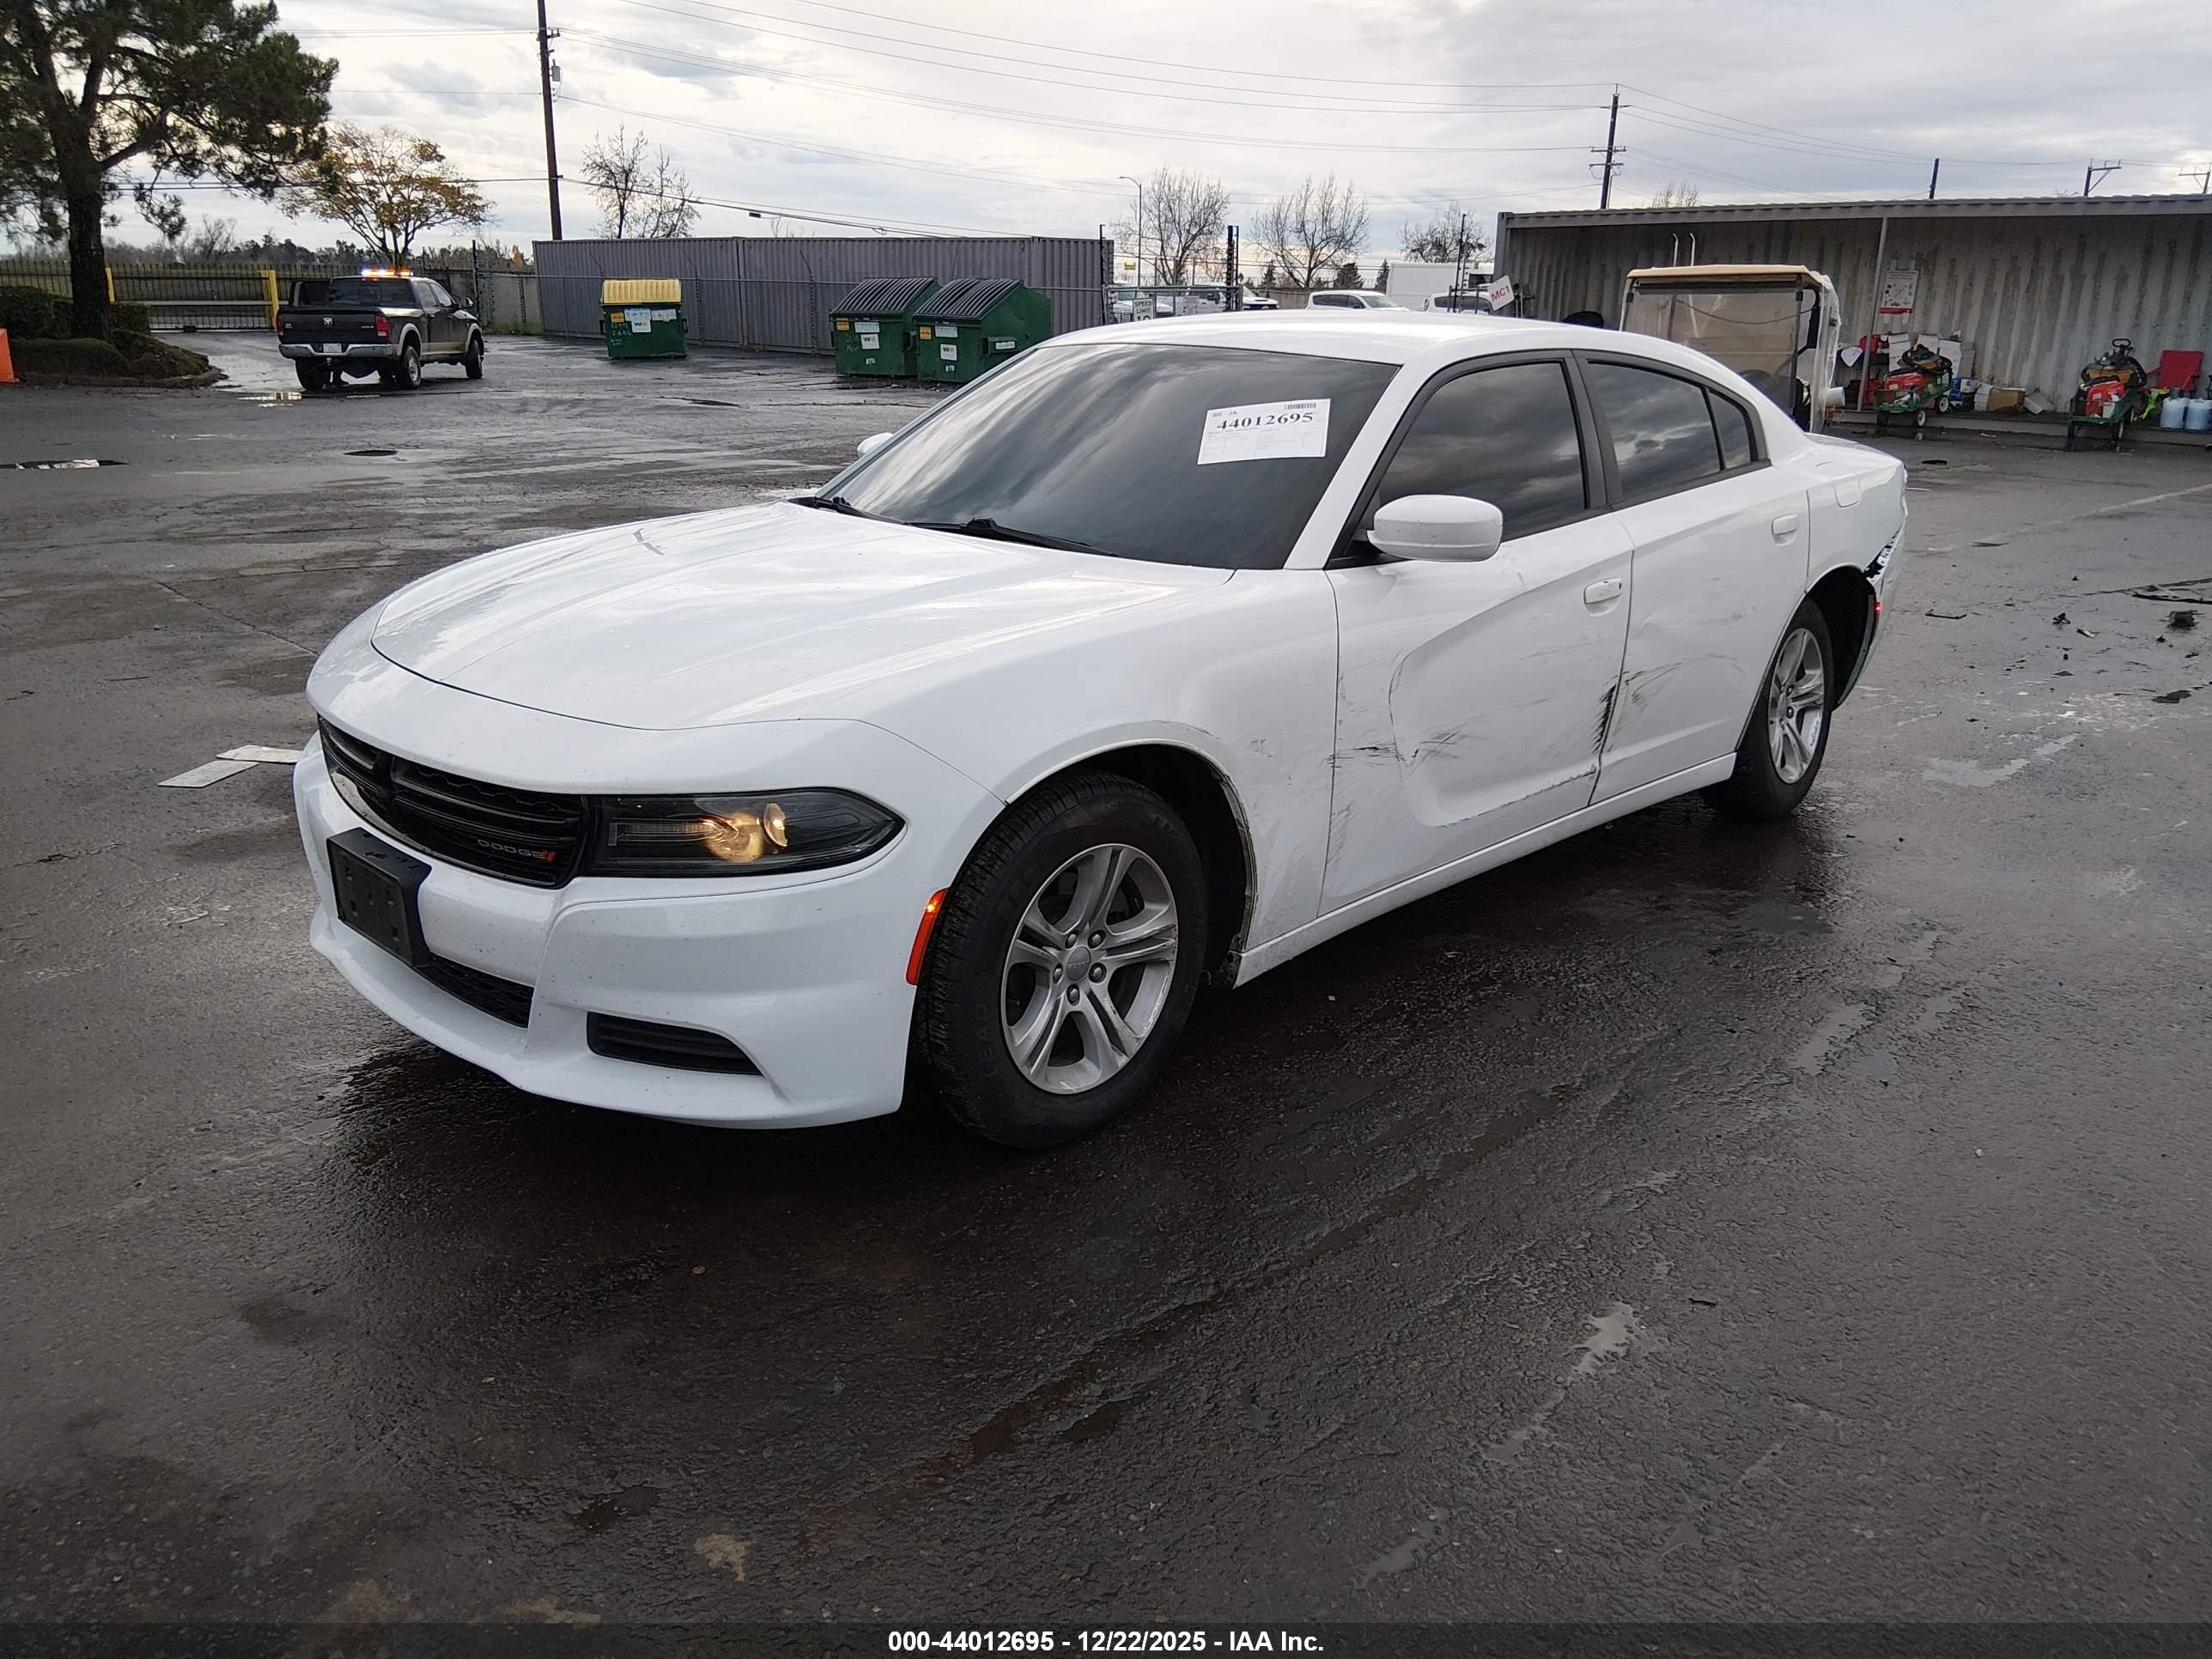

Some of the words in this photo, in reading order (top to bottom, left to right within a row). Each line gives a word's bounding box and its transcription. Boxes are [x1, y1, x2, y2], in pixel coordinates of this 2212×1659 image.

[1491, 285, 1510, 301] MC1
[1216, 412, 1314, 429] 44012695
[477, 839, 545, 859] DODGE
